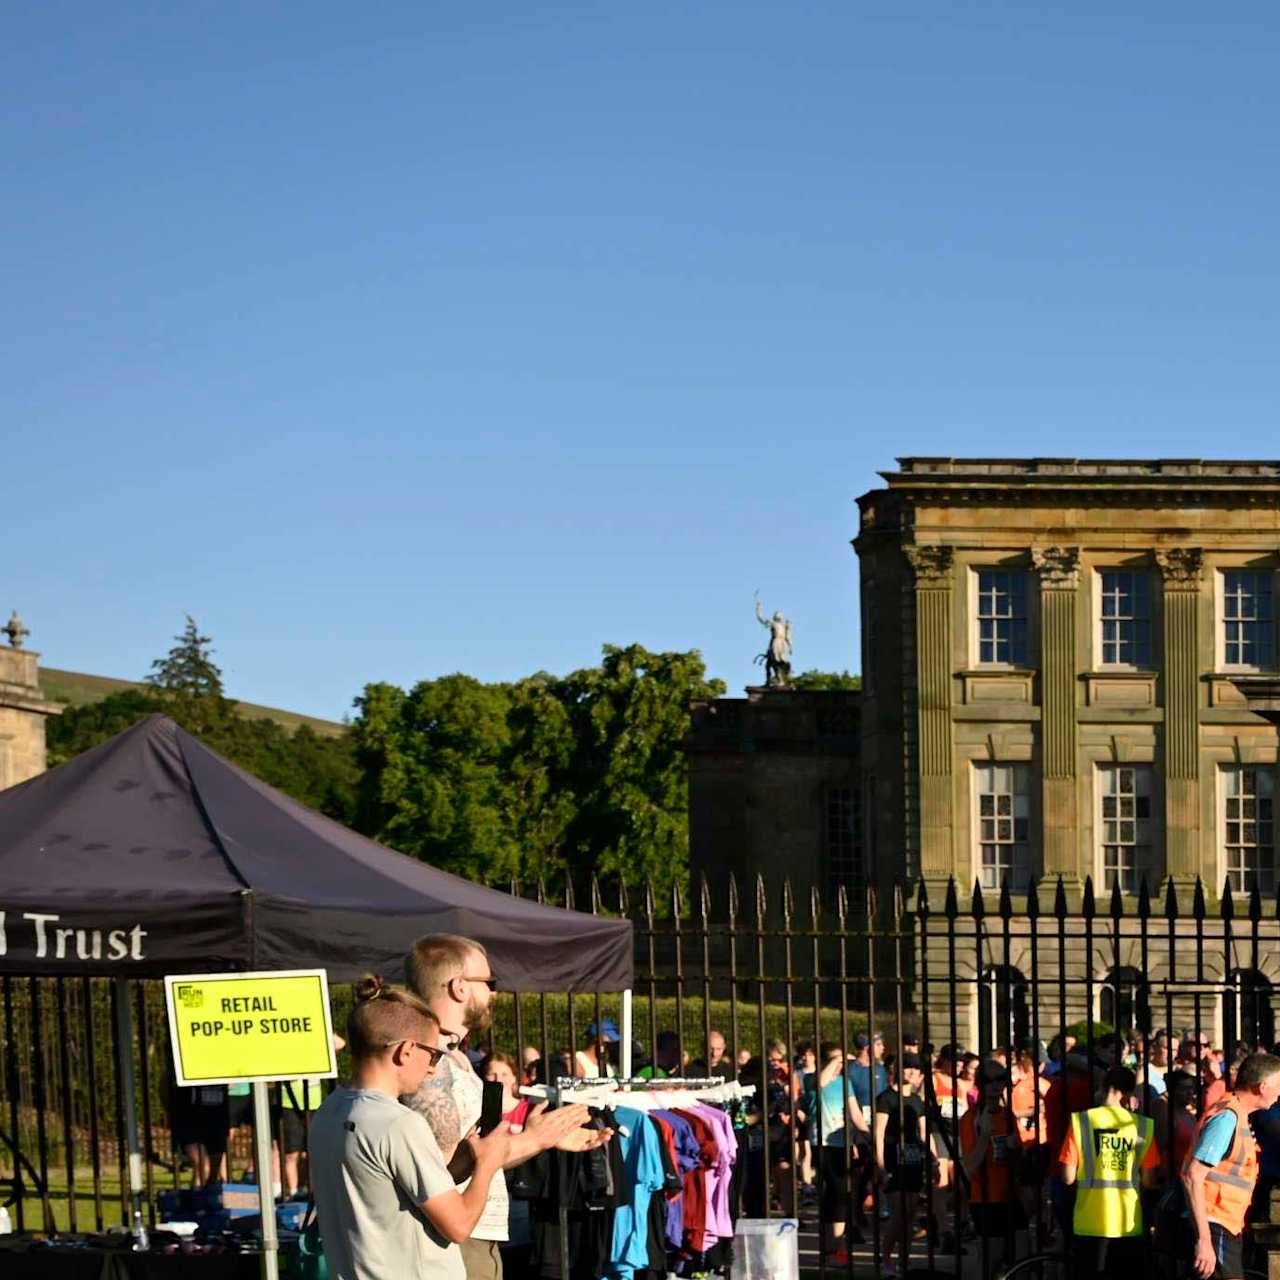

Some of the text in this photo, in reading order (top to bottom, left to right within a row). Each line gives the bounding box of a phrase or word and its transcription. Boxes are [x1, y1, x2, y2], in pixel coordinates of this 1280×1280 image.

[23, 913, 148, 960] Trust
[221, 997, 277, 1013] RETAIL
[191, 1017, 312, 1037] POP-UP STORE
[1101, 1136, 1134, 1151] RUN
